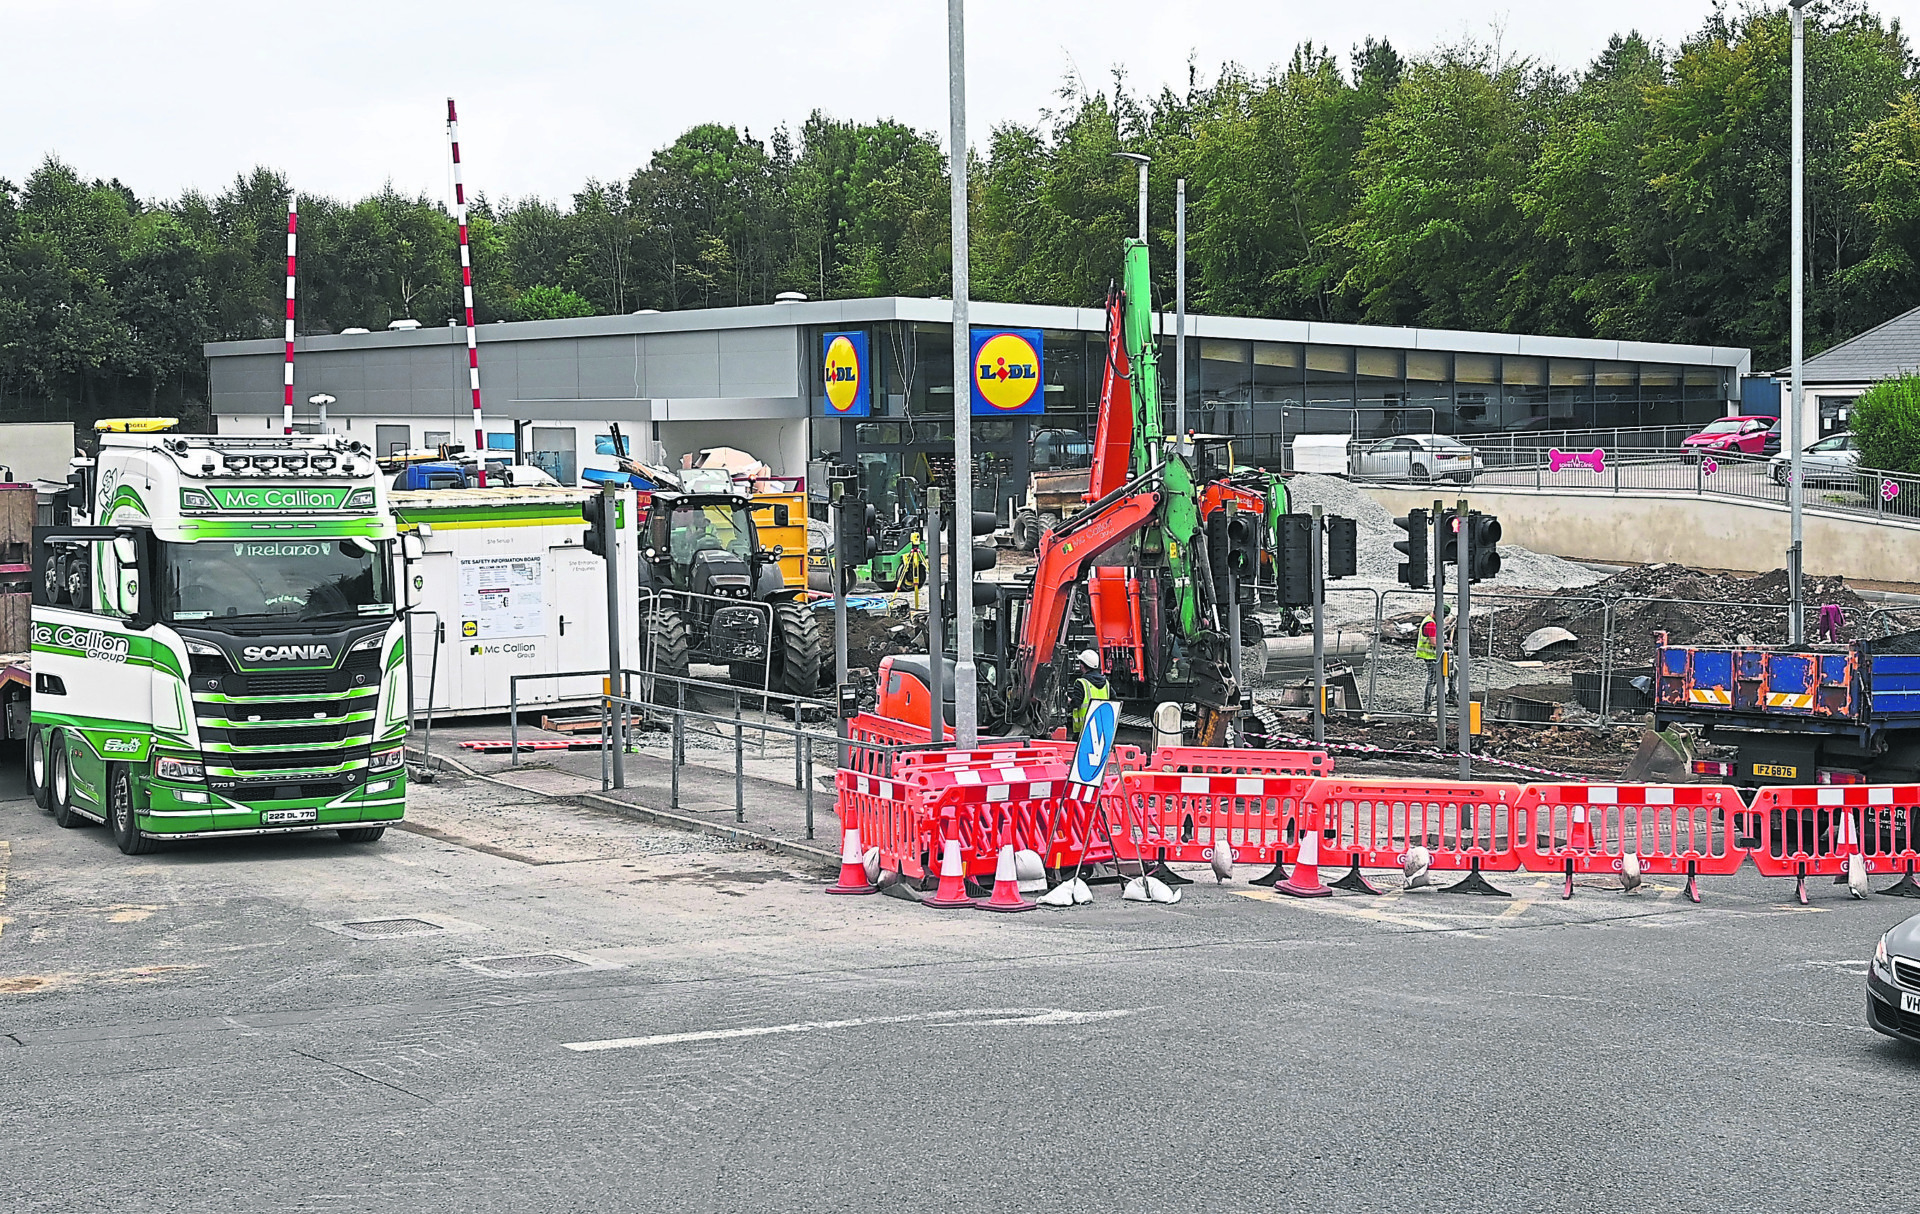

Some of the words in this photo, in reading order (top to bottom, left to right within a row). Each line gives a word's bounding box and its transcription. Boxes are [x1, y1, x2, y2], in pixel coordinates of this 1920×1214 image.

[225, 490, 259, 506] Mc
[264, 489, 336, 506] Callion
[55, 626, 130, 653] Callion
[87, 648, 126, 664] Group
[243, 644, 332, 662] SCANIA
[484, 645, 500, 654] Mc
[502, 643, 536, 653] Callion
[1757, 765, 1770, 775] IFZ
[1771, 766, 1793, 777] 6876
[268, 812, 286, 820] 222
